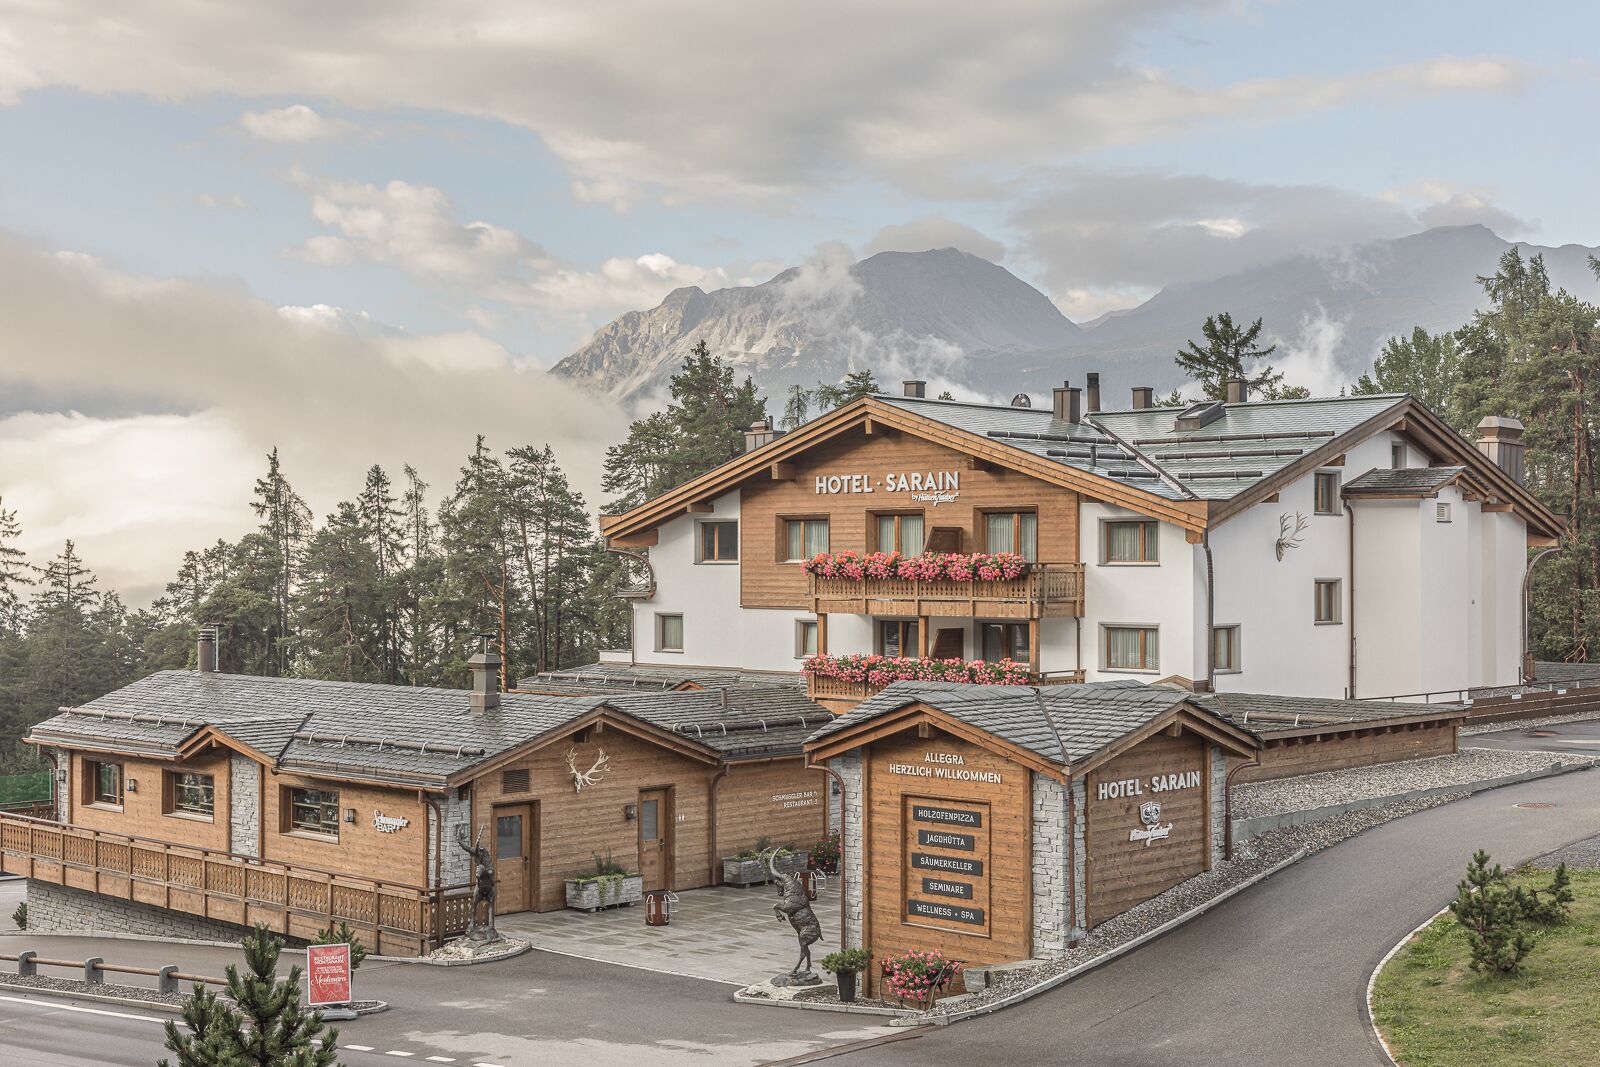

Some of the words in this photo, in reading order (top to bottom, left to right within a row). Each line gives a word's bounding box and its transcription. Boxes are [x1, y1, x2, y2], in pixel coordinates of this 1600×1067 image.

[815, 474, 873, 494] HOTEL
[886, 471, 960, 492] SARAIN
[911, 493, 918, 502] by
[924, 752, 964, 765] ALLEGRA
[889, 764, 932, 777] HERZLICH
[935, 768, 1001, 784] WILLKOMMEN
[1098, 778, 1143, 800] HOTEL
[1151, 771, 1200, 793] SARAIN
[783, 799, 812, 809] RESTAURANT
[918, 809, 975, 823] HOLZOFENPIZZA
[377, 824, 394, 834] BAR
[926, 833, 966, 846] JAGDHÜTTA
[920, 856, 973, 871] SÄUMERKELLER
[929, 882, 964, 894] SEMINARE
[916, 903, 952, 917] WELLNESS
[961, 910, 975, 920] SPA
